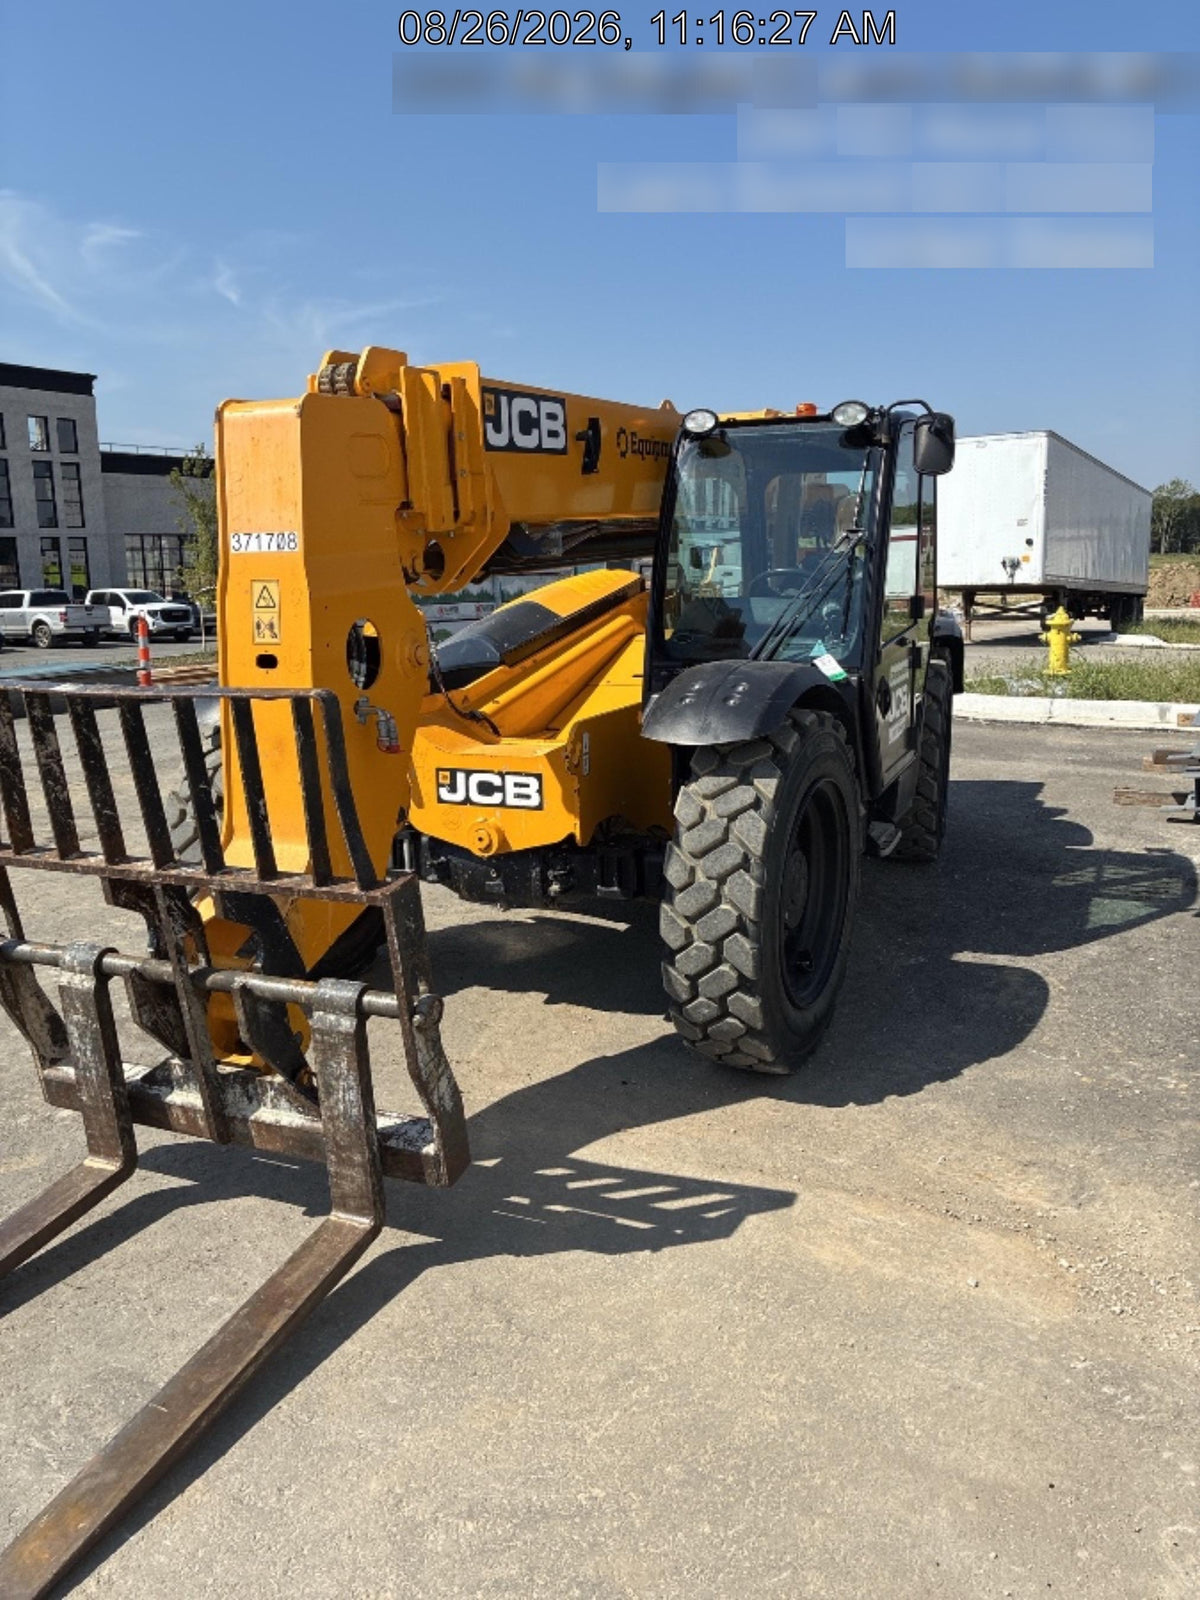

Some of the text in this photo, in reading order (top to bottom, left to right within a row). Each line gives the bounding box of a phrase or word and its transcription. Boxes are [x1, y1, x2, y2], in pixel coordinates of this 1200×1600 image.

[485, 394, 566, 449] JCB
[231, 531, 297, 551] 371708
[438, 771, 541, 807] JCB
